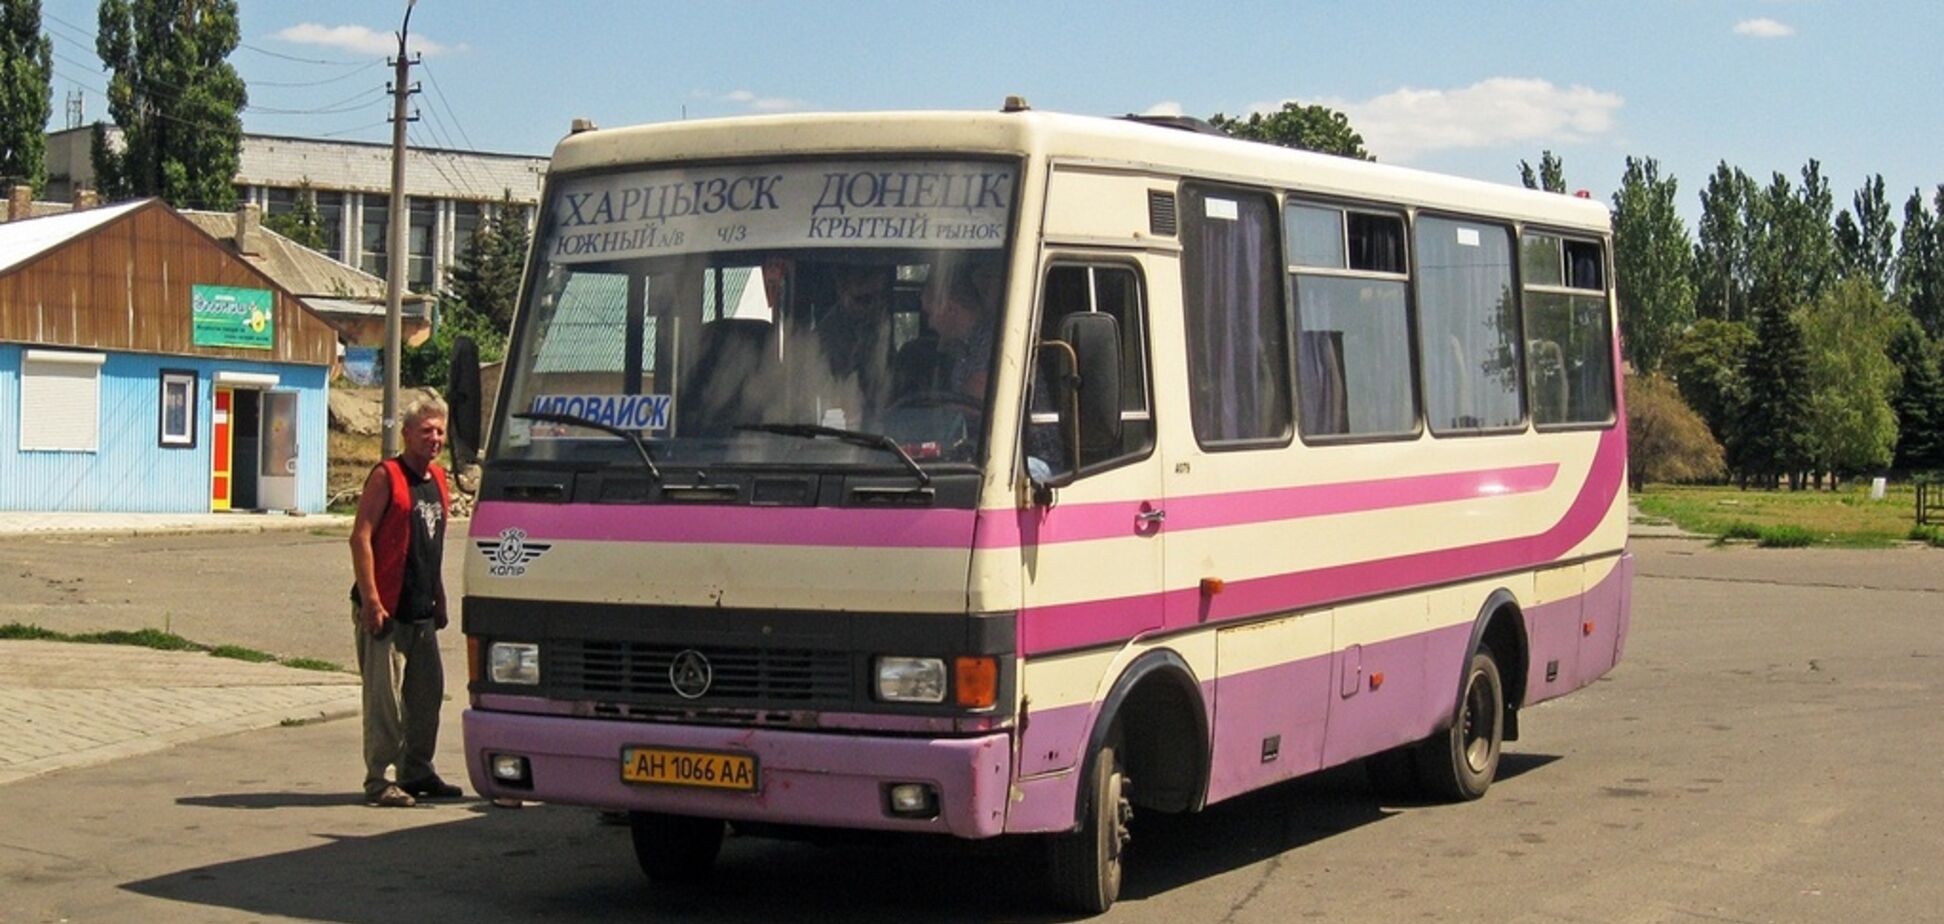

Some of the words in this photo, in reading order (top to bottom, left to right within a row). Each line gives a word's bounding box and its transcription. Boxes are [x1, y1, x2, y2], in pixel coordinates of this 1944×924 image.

[561, 175, 783, 227] ХАРЦЫЗСК
[812, 170, 1009, 216] ДОНЕЦК
[555, 222, 657, 256] ЮЖНЫЙ
[807, 212, 930, 239] КРЫТЫЙ
[935, 222, 1002, 240] РЫНОК
[636, 754, 666, 778] AH
[671, 756, 716, 781] 1066
[720, 760, 749, 784] AA
